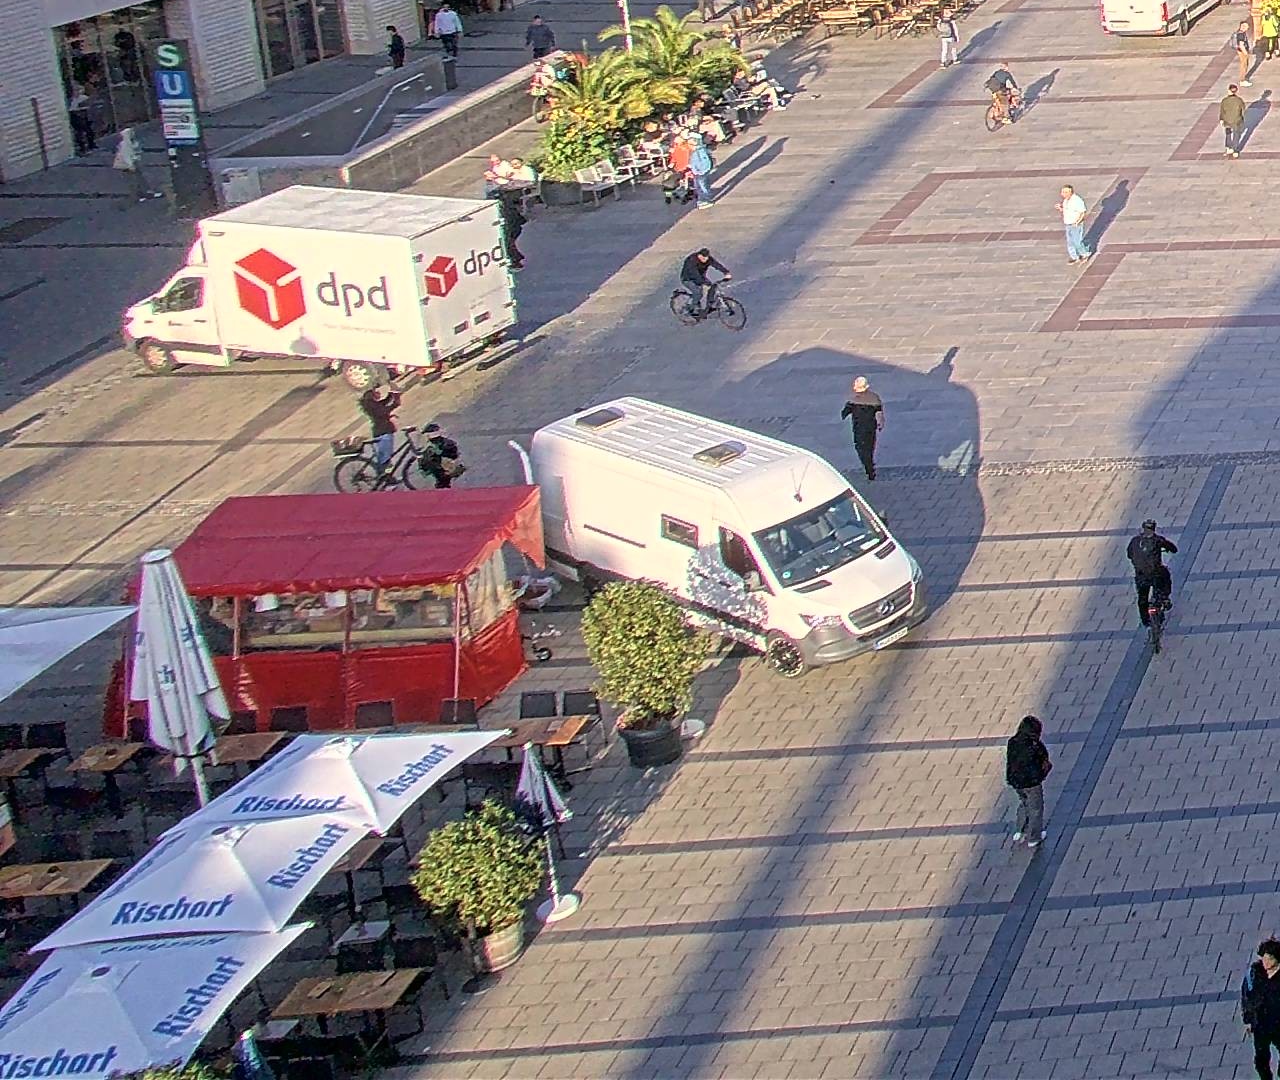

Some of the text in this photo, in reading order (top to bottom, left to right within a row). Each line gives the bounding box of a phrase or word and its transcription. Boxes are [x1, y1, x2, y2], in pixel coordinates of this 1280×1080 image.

[158, 44, 180, 67] S
[162, 73, 182, 96] U
[316, 271, 391, 317] dpd
[376, 743, 454, 797] Rischart
[231, 794, 346, 814] Rischart
[266, 823, 349, 889] Rischart
[111, 893, 234, 926] Rischart
[152, 955, 245, 1037] Rischart
